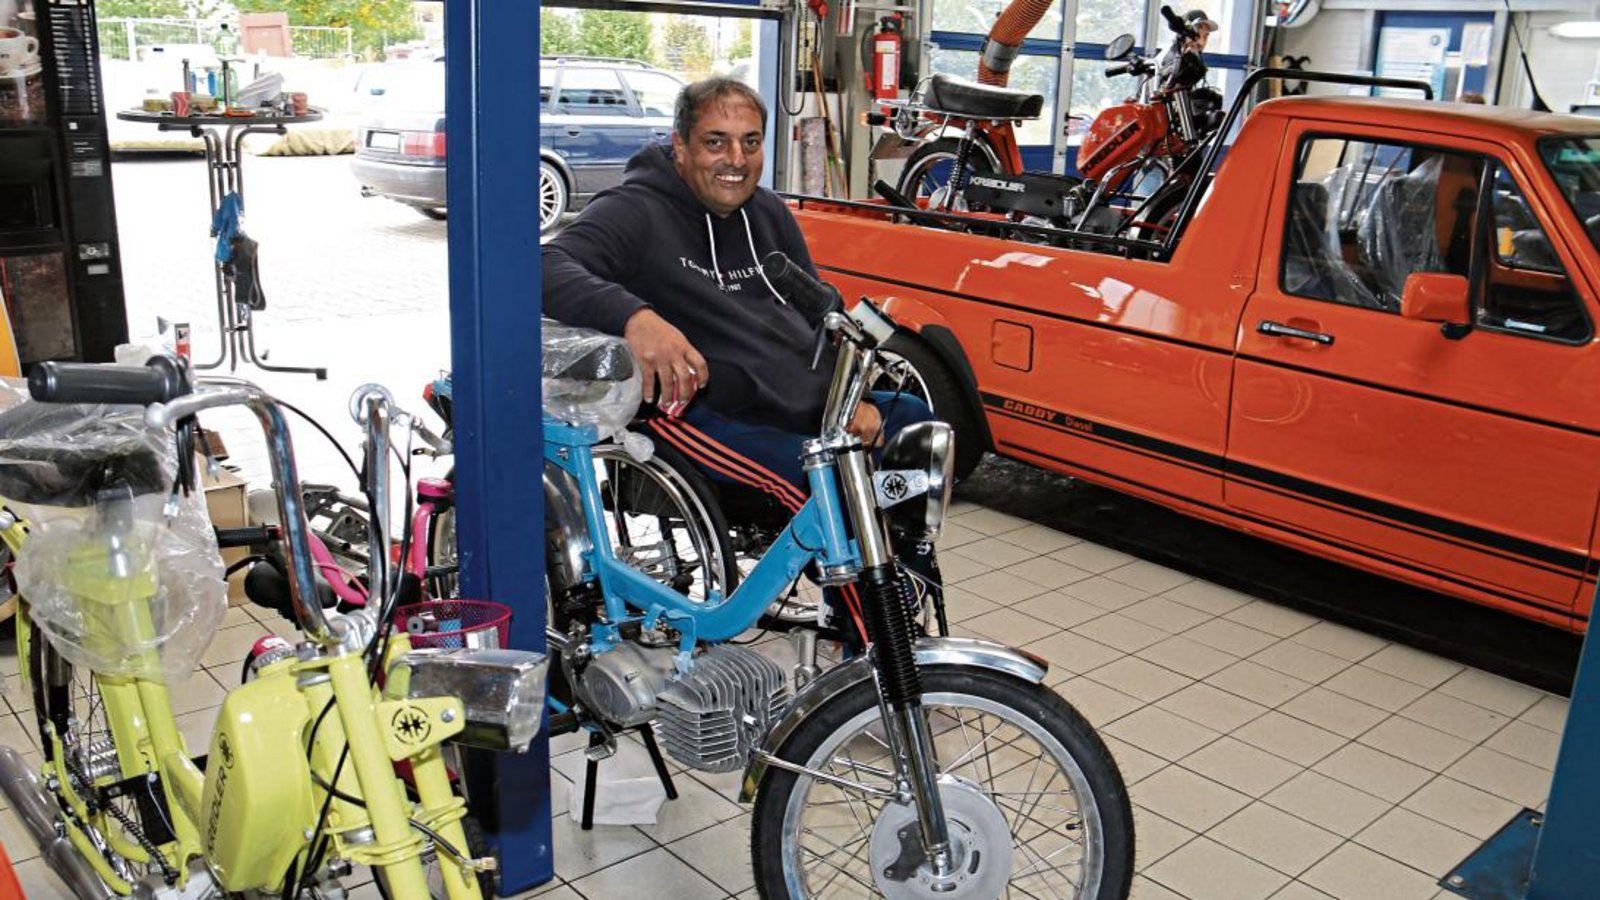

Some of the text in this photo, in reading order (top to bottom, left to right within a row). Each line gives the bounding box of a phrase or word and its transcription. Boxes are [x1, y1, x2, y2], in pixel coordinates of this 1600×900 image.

[1081, 121, 1141, 175] KREIDLER
[969, 175, 1026, 193] KREIDLER
[1003, 400, 1057, 421] CADDY
